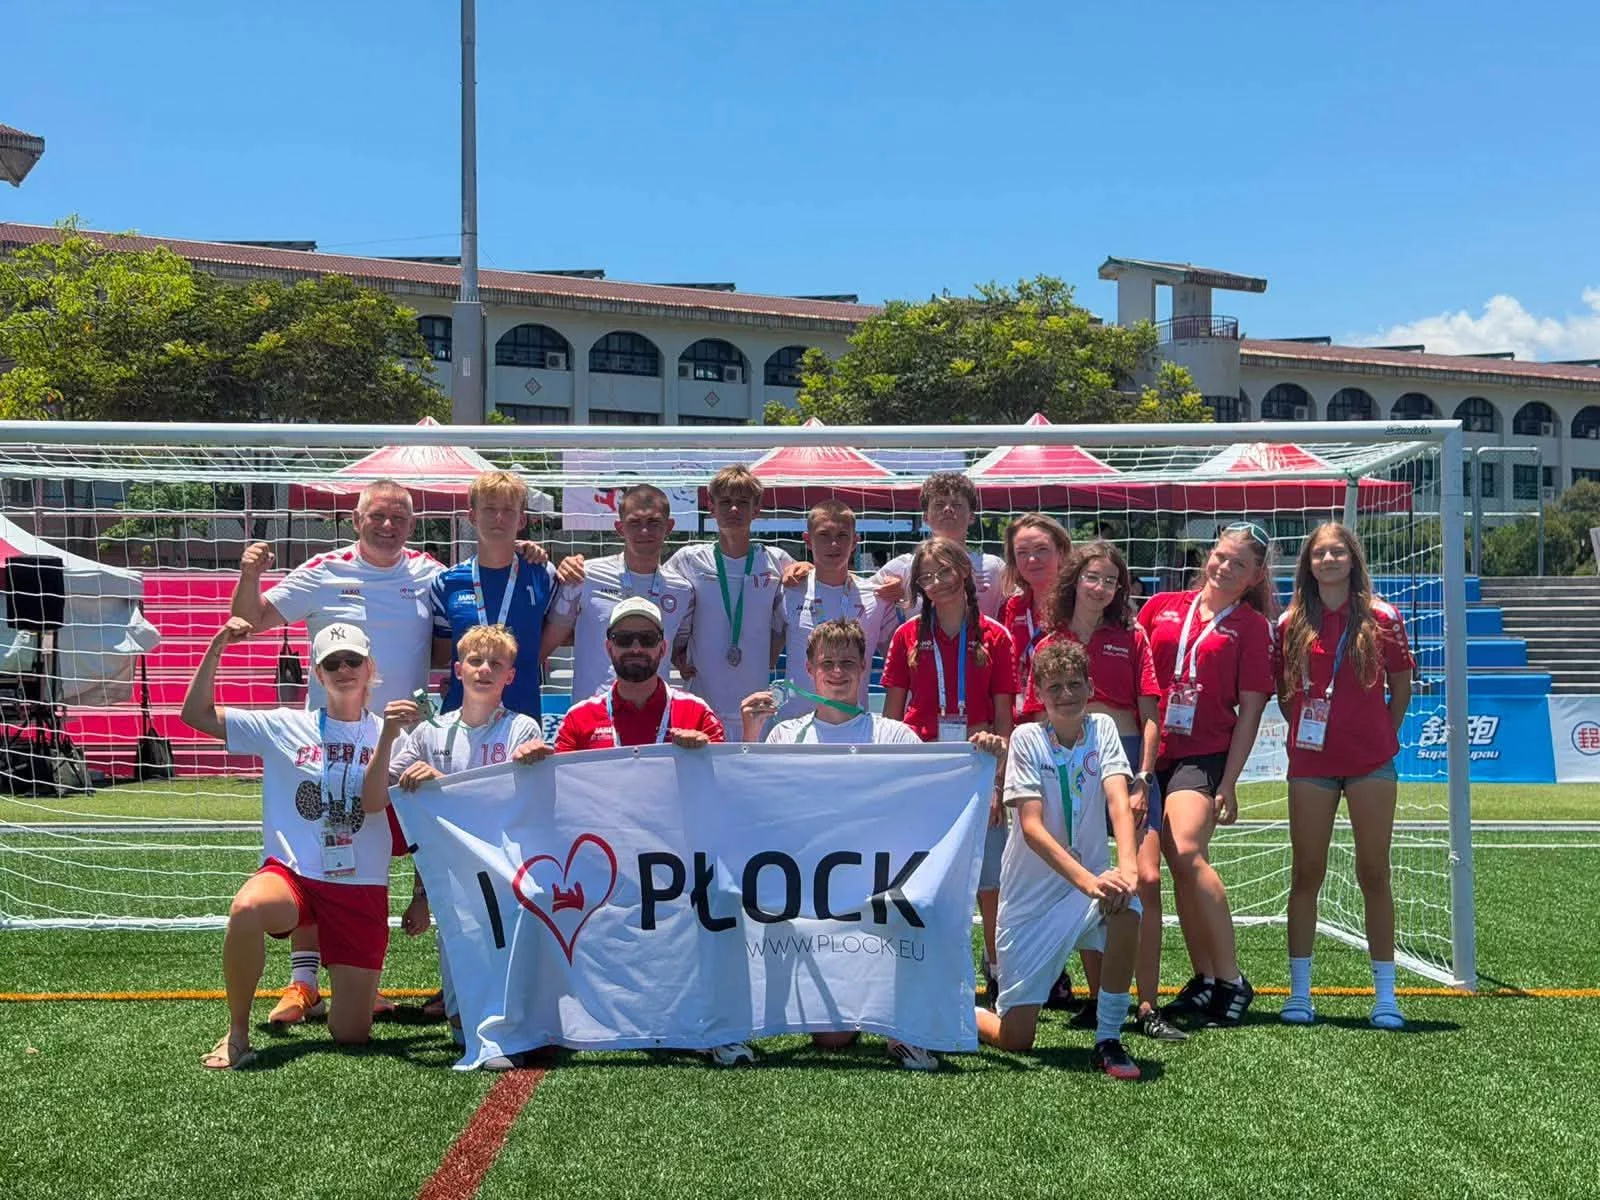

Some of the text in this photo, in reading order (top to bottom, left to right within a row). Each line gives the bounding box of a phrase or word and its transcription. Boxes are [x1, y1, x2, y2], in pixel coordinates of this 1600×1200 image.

[526, 585, 536, 606] 1
[330, 627, 346, 641] NY
[481, 743, 507, 765] 18
[477, 850, 930, 949] I PŁOCK
[745, 934, 925, 962] WWW.PLOCK.EU
